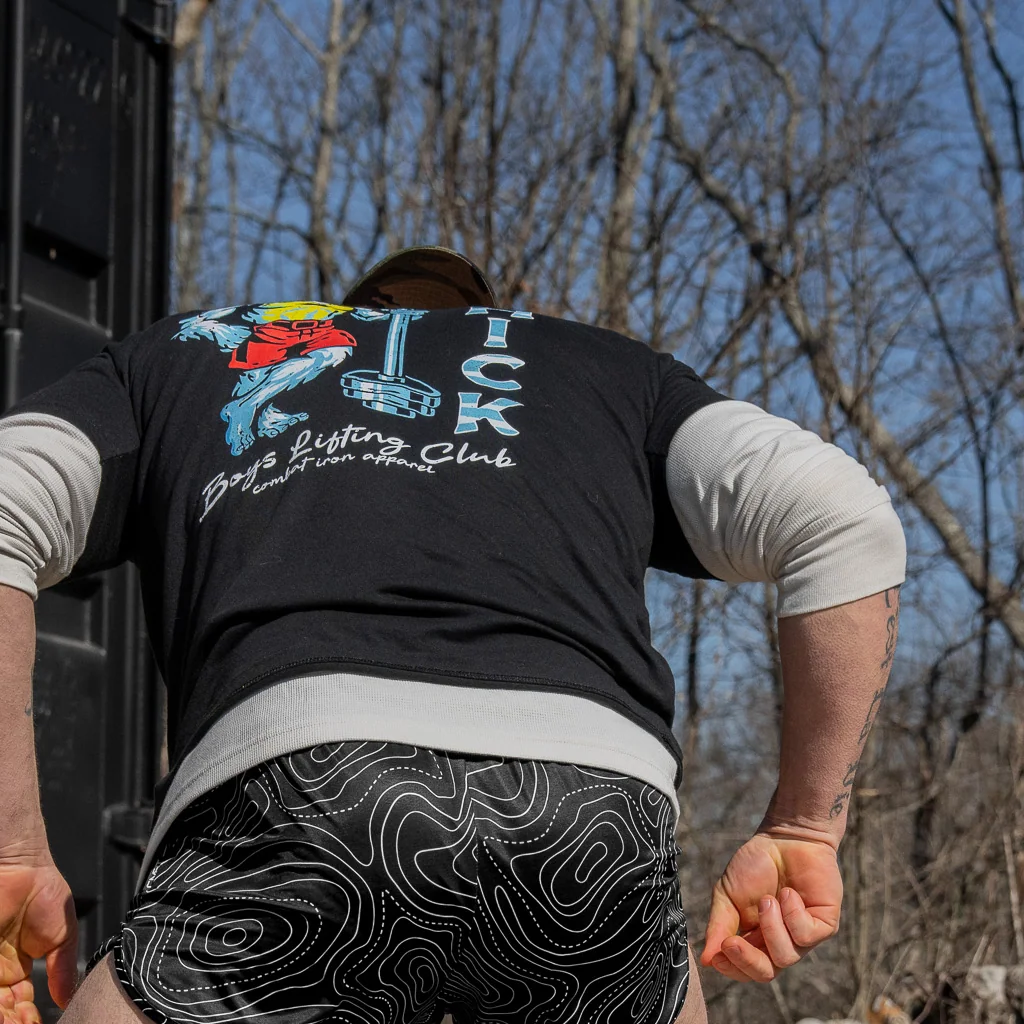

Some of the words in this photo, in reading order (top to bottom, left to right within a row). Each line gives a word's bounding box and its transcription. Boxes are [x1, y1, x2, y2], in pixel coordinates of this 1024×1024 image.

[199, 451, 276, 523] Boys
[289, 424, 411, 463] Lifting
[421, 442, 516, 468] Club
[253, 456, 315, 494] combat
[316, 453, 356, 468] iron
[363, 453, 436, 474] apparel
